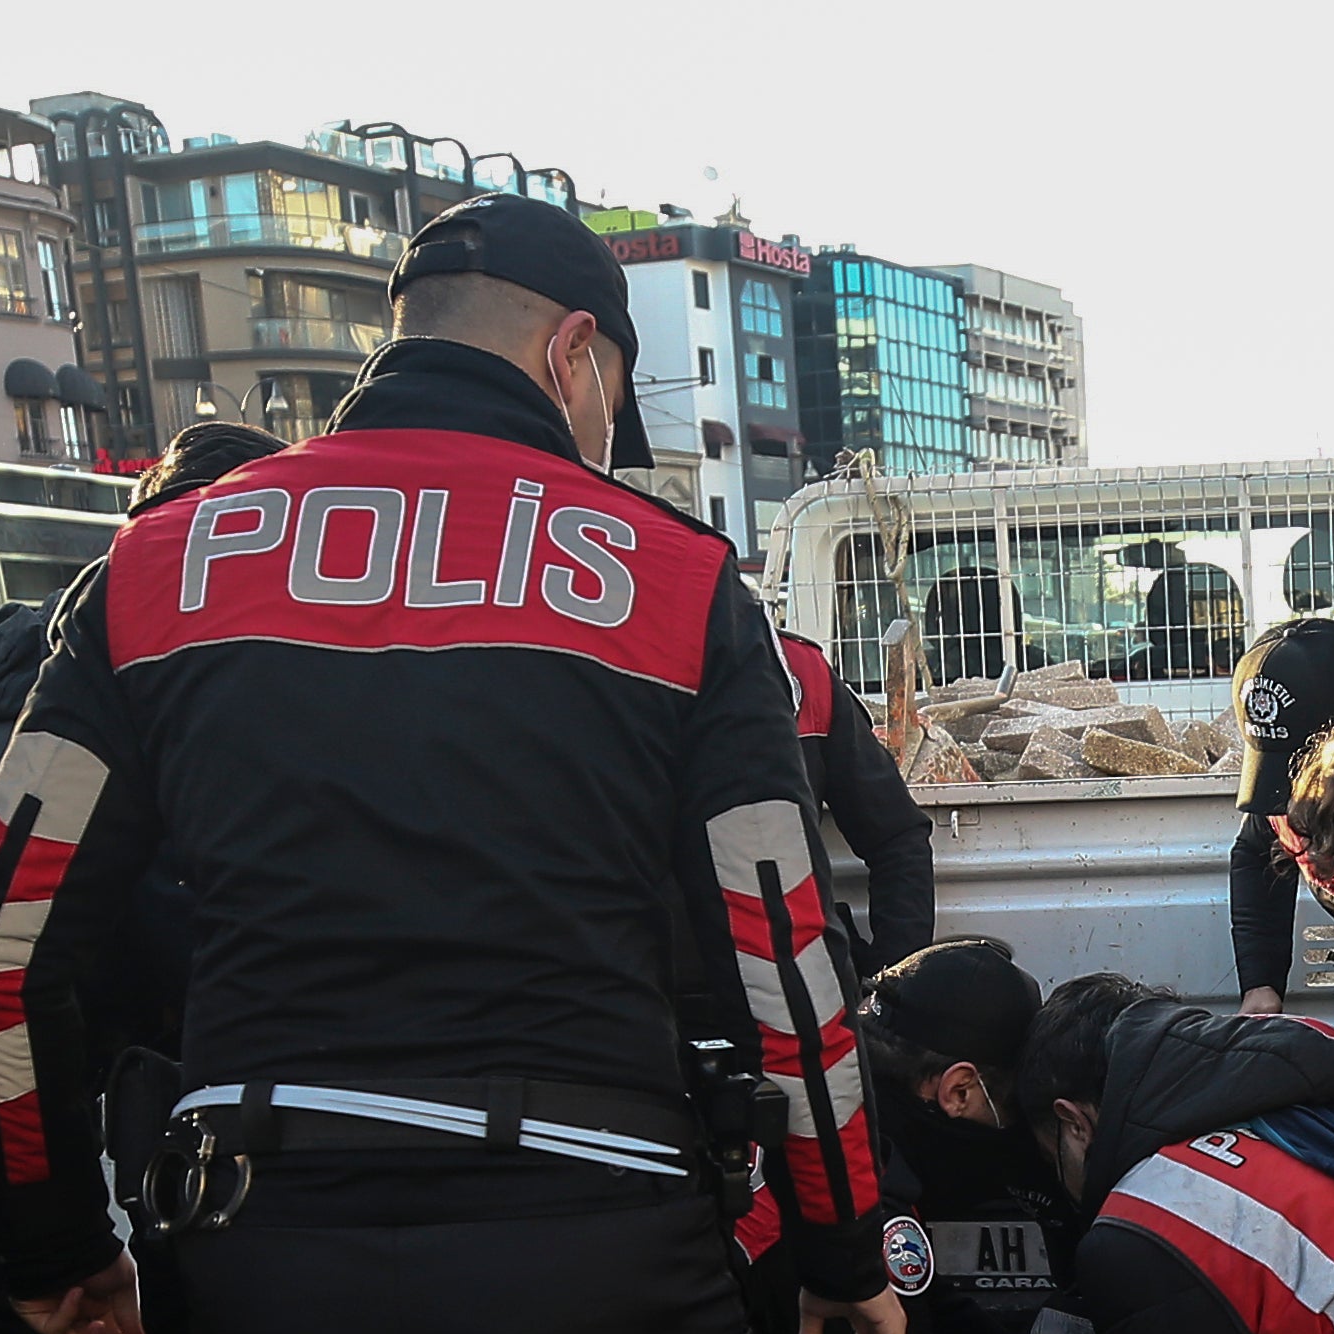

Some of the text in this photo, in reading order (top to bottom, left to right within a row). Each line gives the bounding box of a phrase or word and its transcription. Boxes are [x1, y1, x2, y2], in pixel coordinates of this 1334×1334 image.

[757, 236, 811, 274] Hosta
[178, 478, 637, 628] POLİS
[975, 1277, 1057, 1288] GARA
